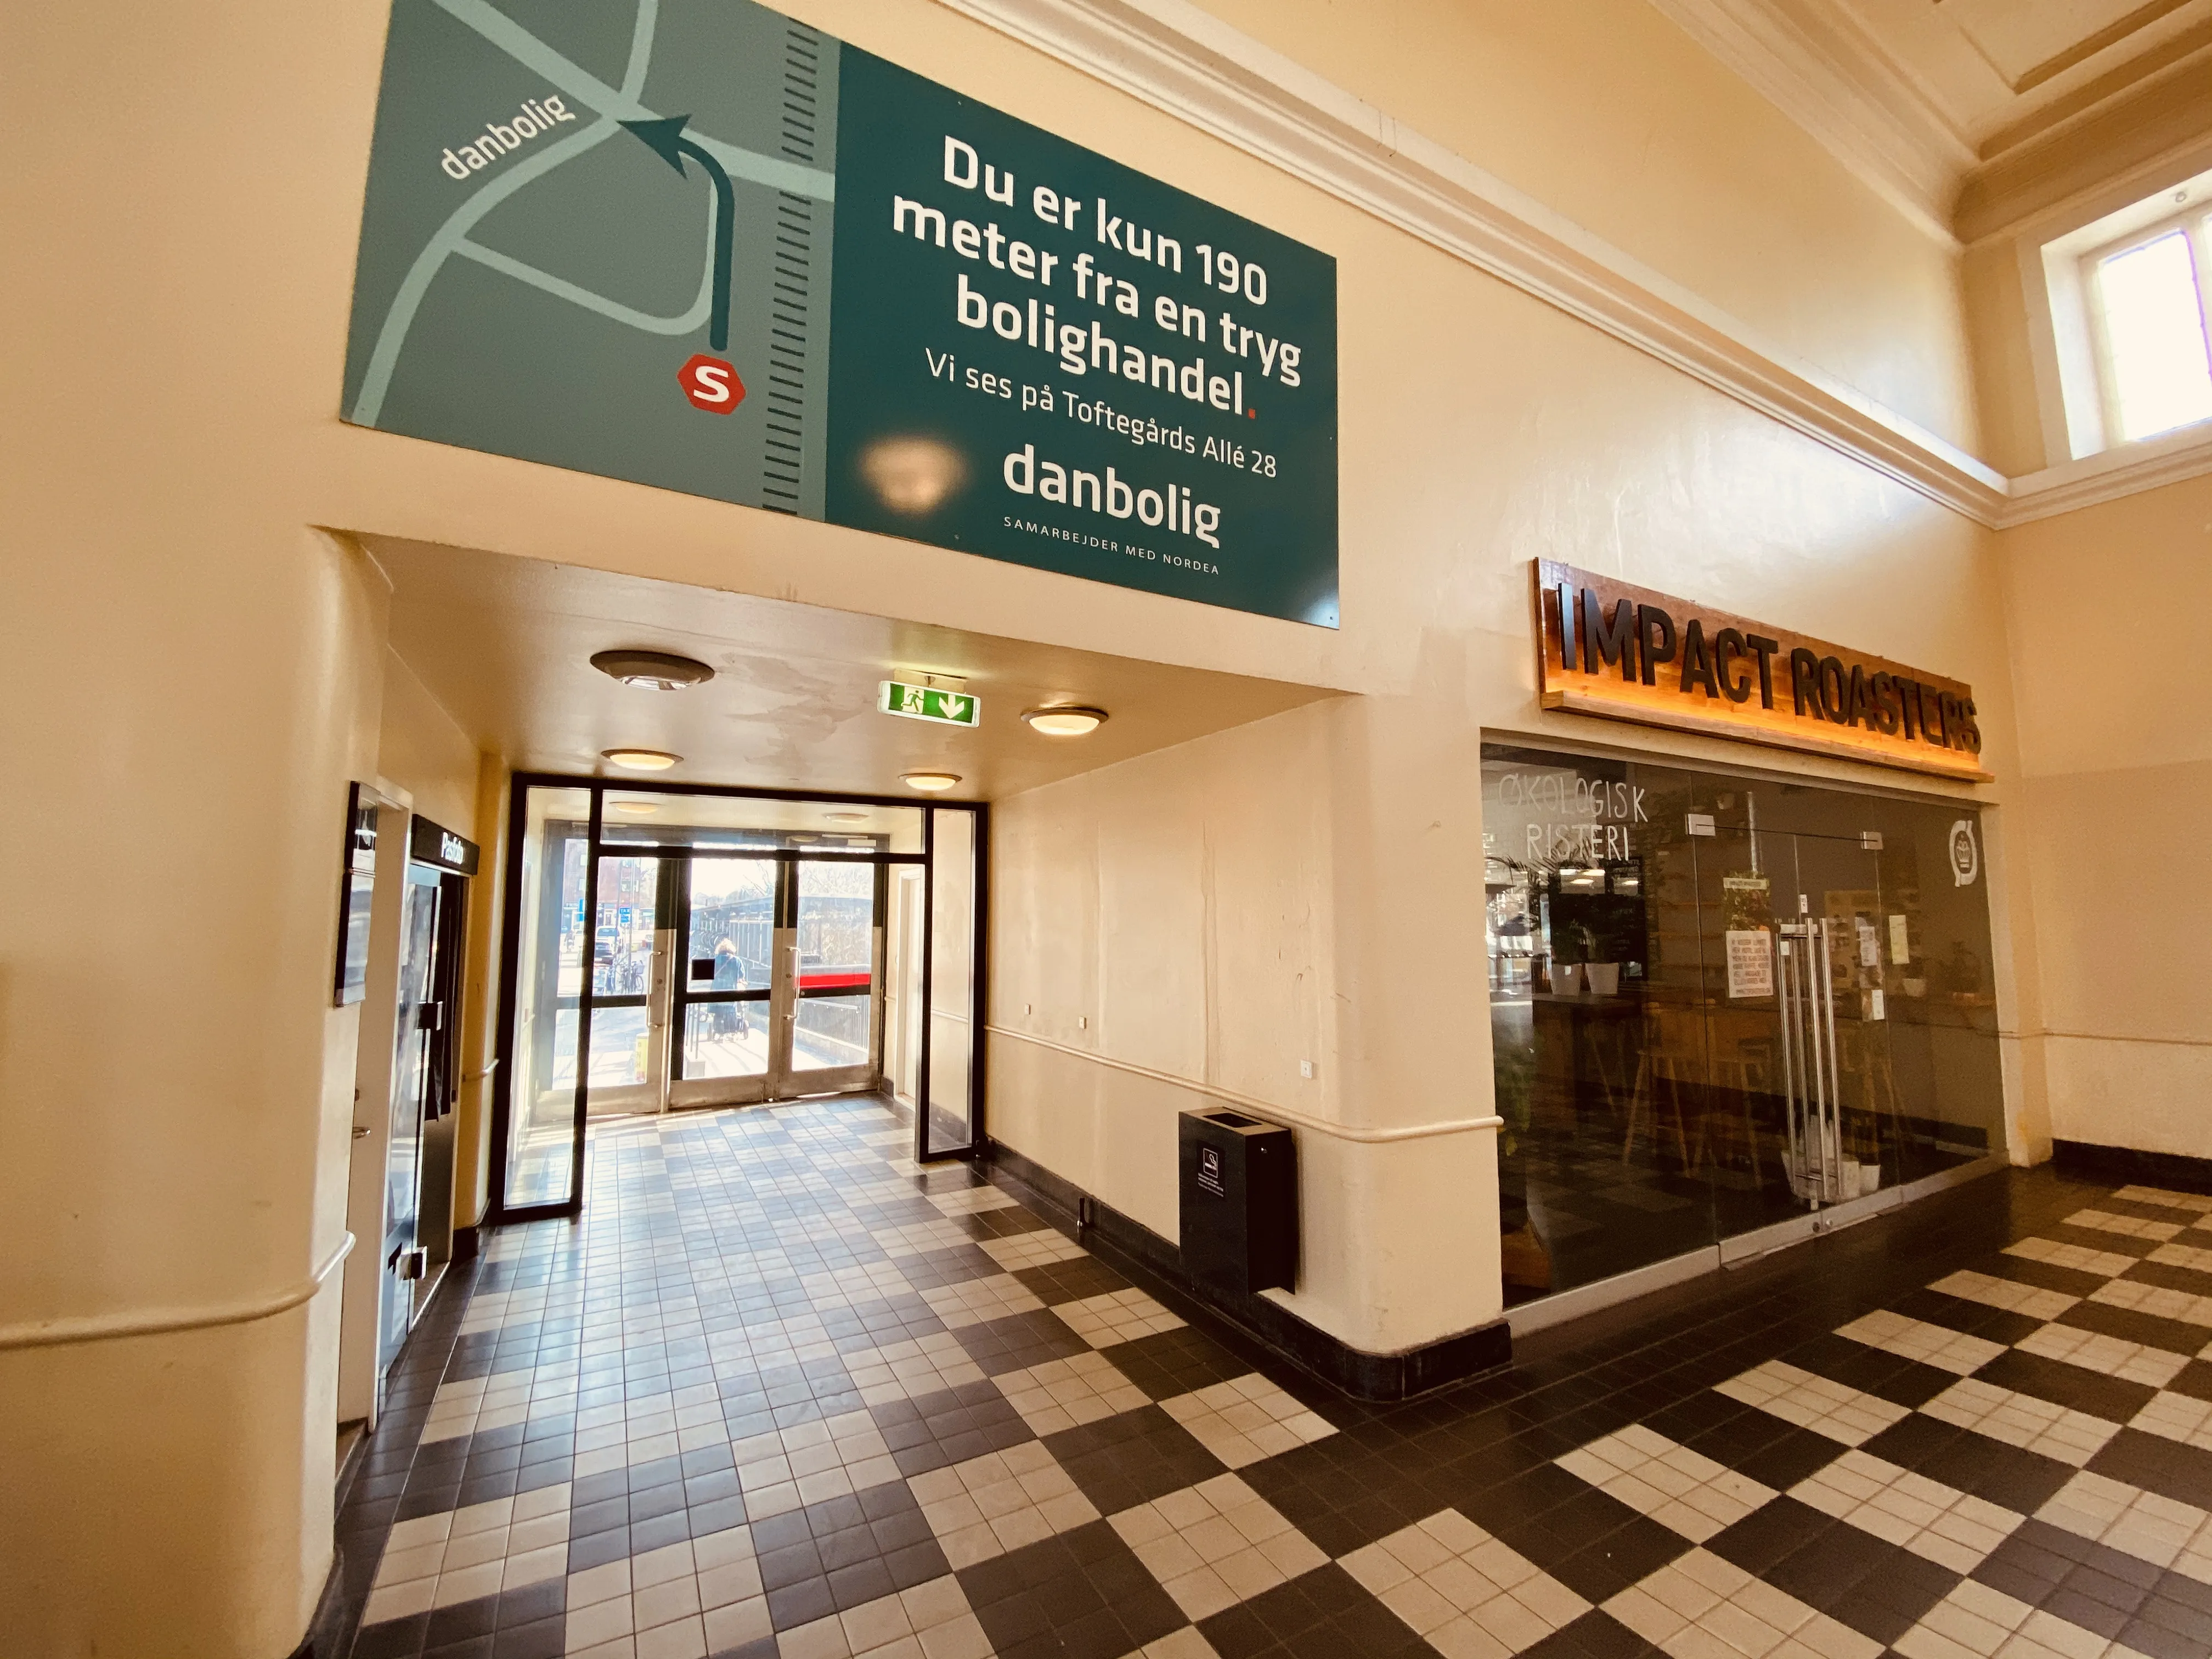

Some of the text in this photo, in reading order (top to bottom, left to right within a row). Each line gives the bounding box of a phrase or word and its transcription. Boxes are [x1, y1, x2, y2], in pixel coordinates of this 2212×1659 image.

[441, 94, 577, 180] danbolig
[944, 134, 1267, 306] Du er kun 190
[893, 194, 1302, 387] meter fra en tryg
[692, 364, 730, 403] S
[957, 273, 1256, 419] bolighandel.
[925, 347, 1277, 478] Vi ses på Toftegårds Allé 28
[1003, 443, 1221, 549] danbolig
[1003, 516, 1219, 575] SAMARBEJDER MED NORDEA
[1558, 582, 1982, 755] IMPACT ROASTERS
[1498, 772, 1648, 822] ØKOLOGISK
[1526, 823, 1630, 861] RISTERI
